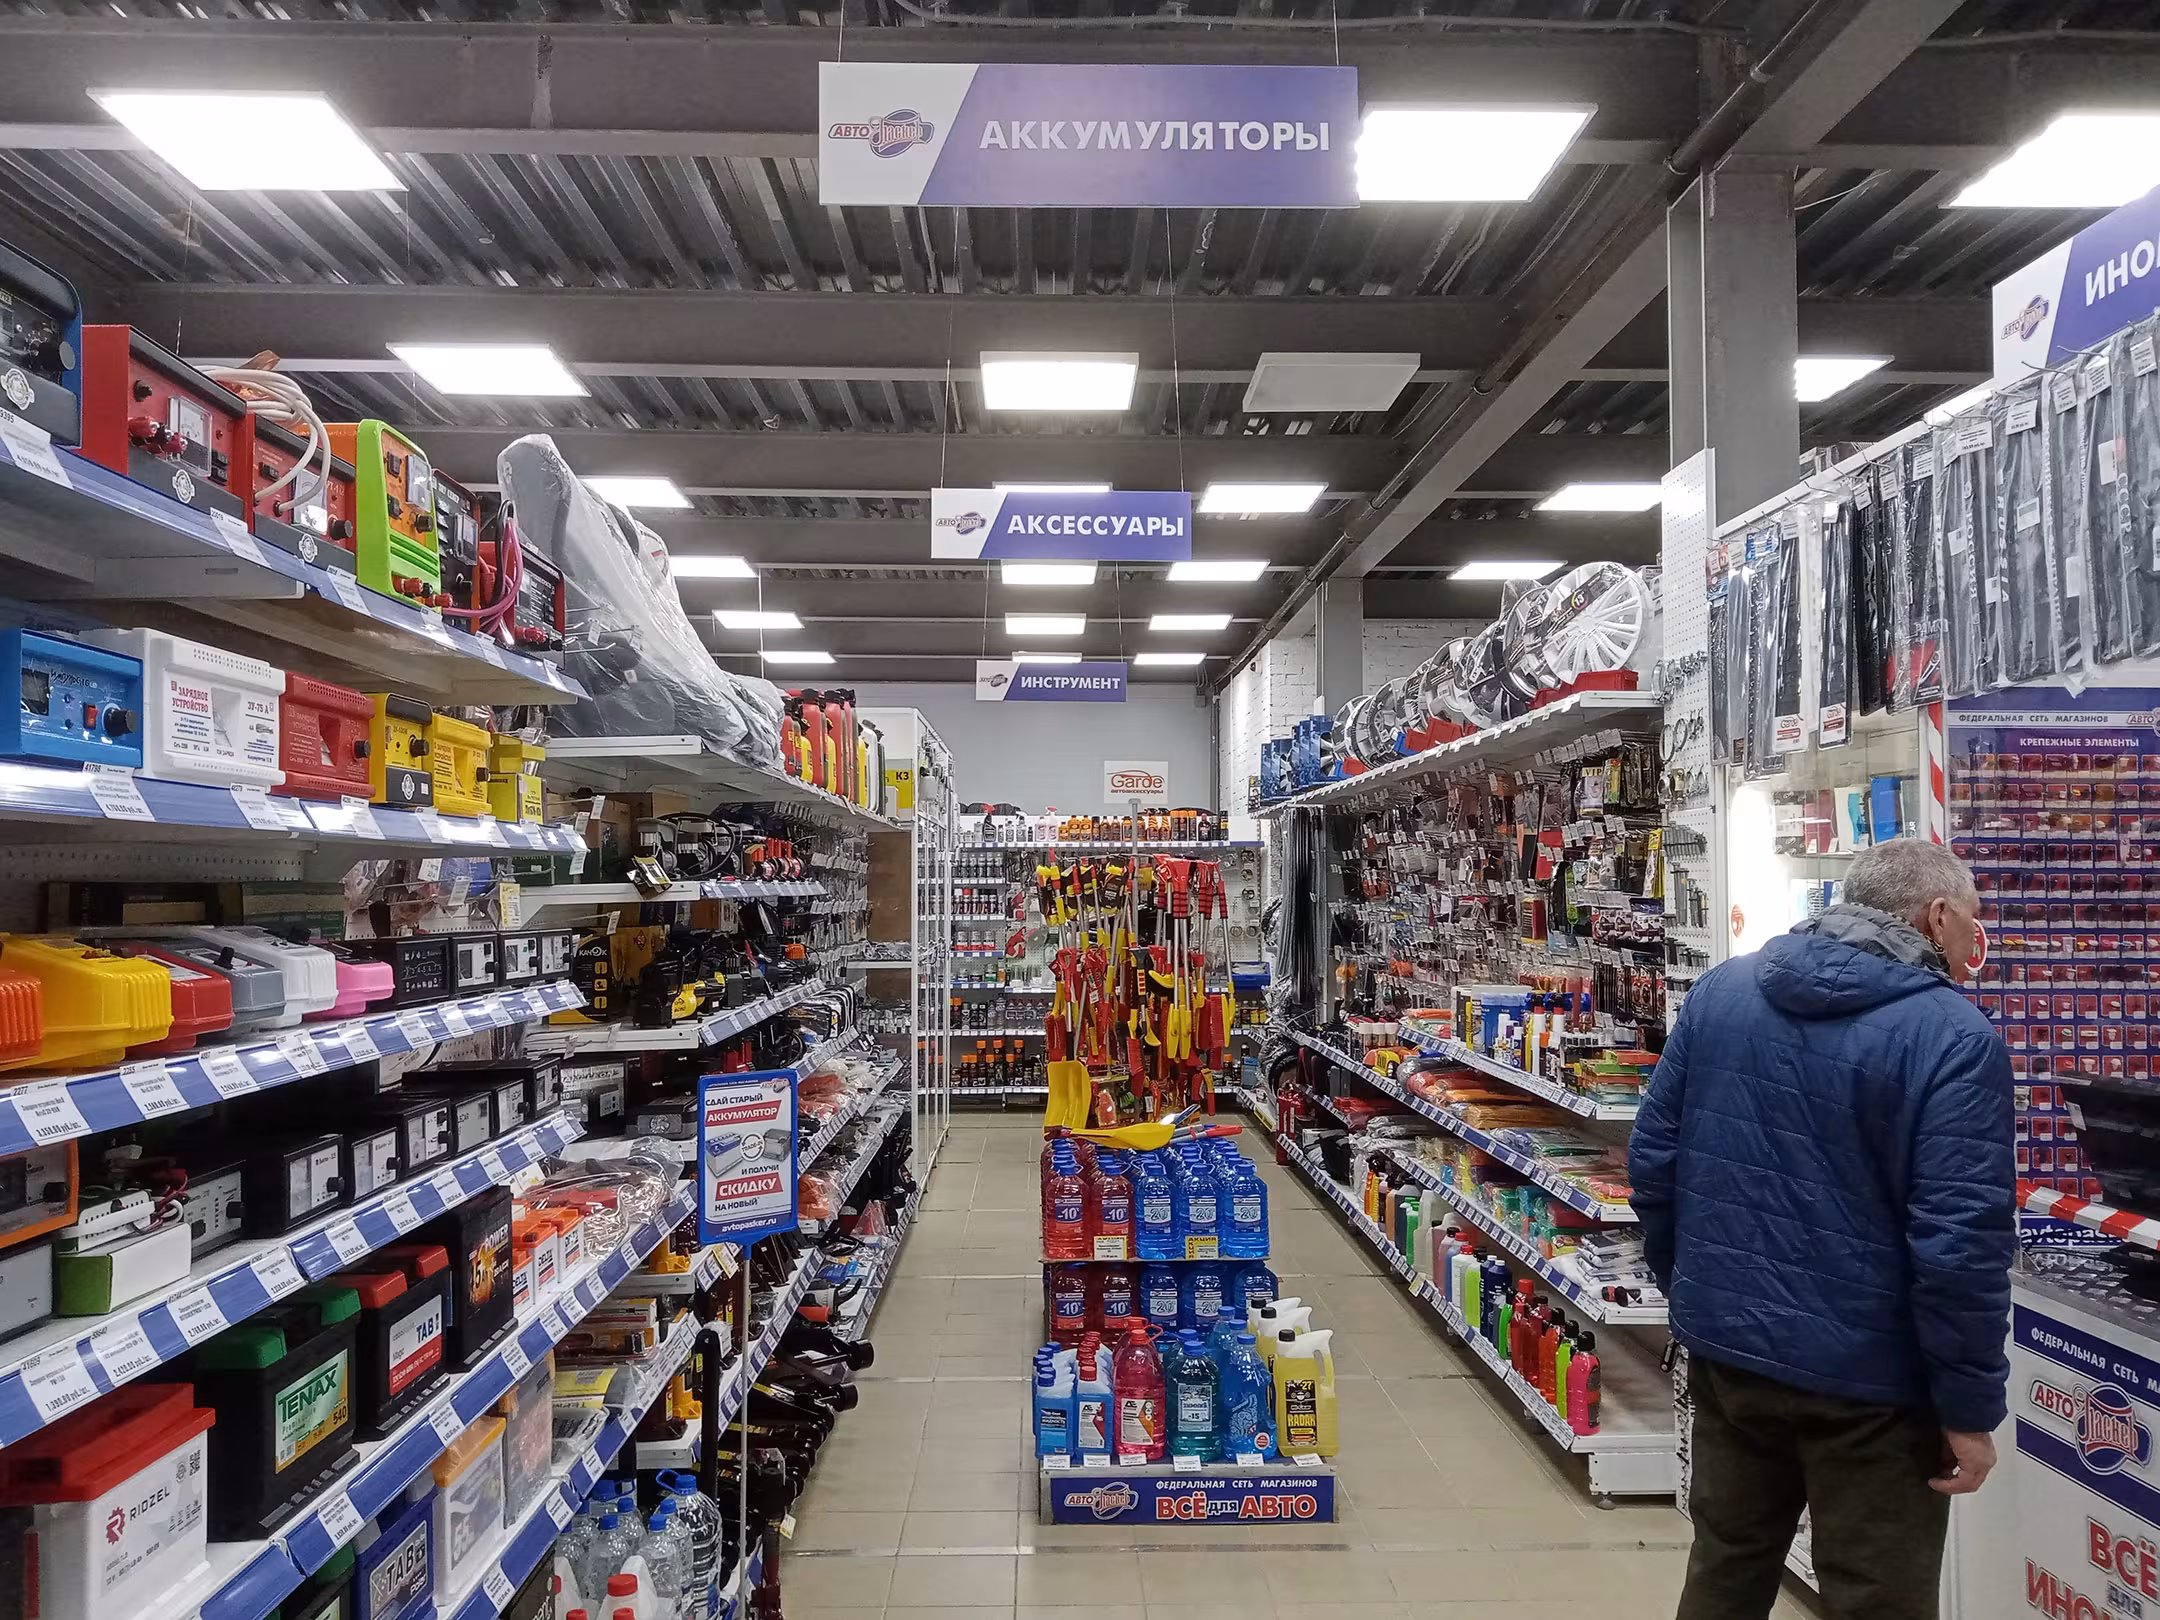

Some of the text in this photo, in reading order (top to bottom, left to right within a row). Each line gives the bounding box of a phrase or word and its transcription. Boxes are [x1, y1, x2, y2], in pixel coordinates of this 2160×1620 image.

[833, 126, 870, 138] АВТО
[979, 121, 1330, 151] АККУМУЛЯТОРЫ
[2085, 231, 2160, 307] ИНО
[1007, 515, 1184, 536] АКСЕССУАРЫ
[1021, 677, 1121, 690] ИНСТРУМЕНТ
[178, 687, 209, 701] ЗАРЯДНОЕ
[172, 698, 209, 713] УСТРОЙСТВО
[1958, 714, 2154, 724] ФЕДЕРАЛЬНАЯ СЕТЬ МАГАЗИНОВ АВТО
[2020, 738, 2139, 747] КРЕПЕЖНЫЕ ЭЛЕМЕНТЫ
[1111, 772, 1164, 788] Garde
[705, 1093, 763, 1106] СДАЙ СТАРЫЙ
[707, 1107, 778, 1122] АККУМУЛЯТОР
[748, 1164, 780, 1174] ПОЛУЧИ
[719, 1178, 777, 1197] СКИДКУ
[714, 1204, 727, 1212] НА
[416, 1317, 434, 1344] TAB
[2030, 1326, 2106, 1369] ФЕДЕРАЛЬНАЯ
[2112, 1362, 2140, 1384] СЕТЬ
[277, 1363, 338, 1424] TENAX
[2034, 1384, 2075, 1419] АВТО
[333, 1405, 347, 1425] 540
[1287, 1413, 1316, 1427] RADAR
[1156, 1479, 1318, 1489] ФЕДЕРАЛЬНАЯ СЕТЬ МАГАЗИНОВ
[129, 1486, 170, 1520] RIDZEL
[1068, 1496, 1094, 1504] АВТО
[1157, 1492, 1317, 1519] ВСЁ для АВТО
[2089, 1519, 2160, 1602] ВСЁ
